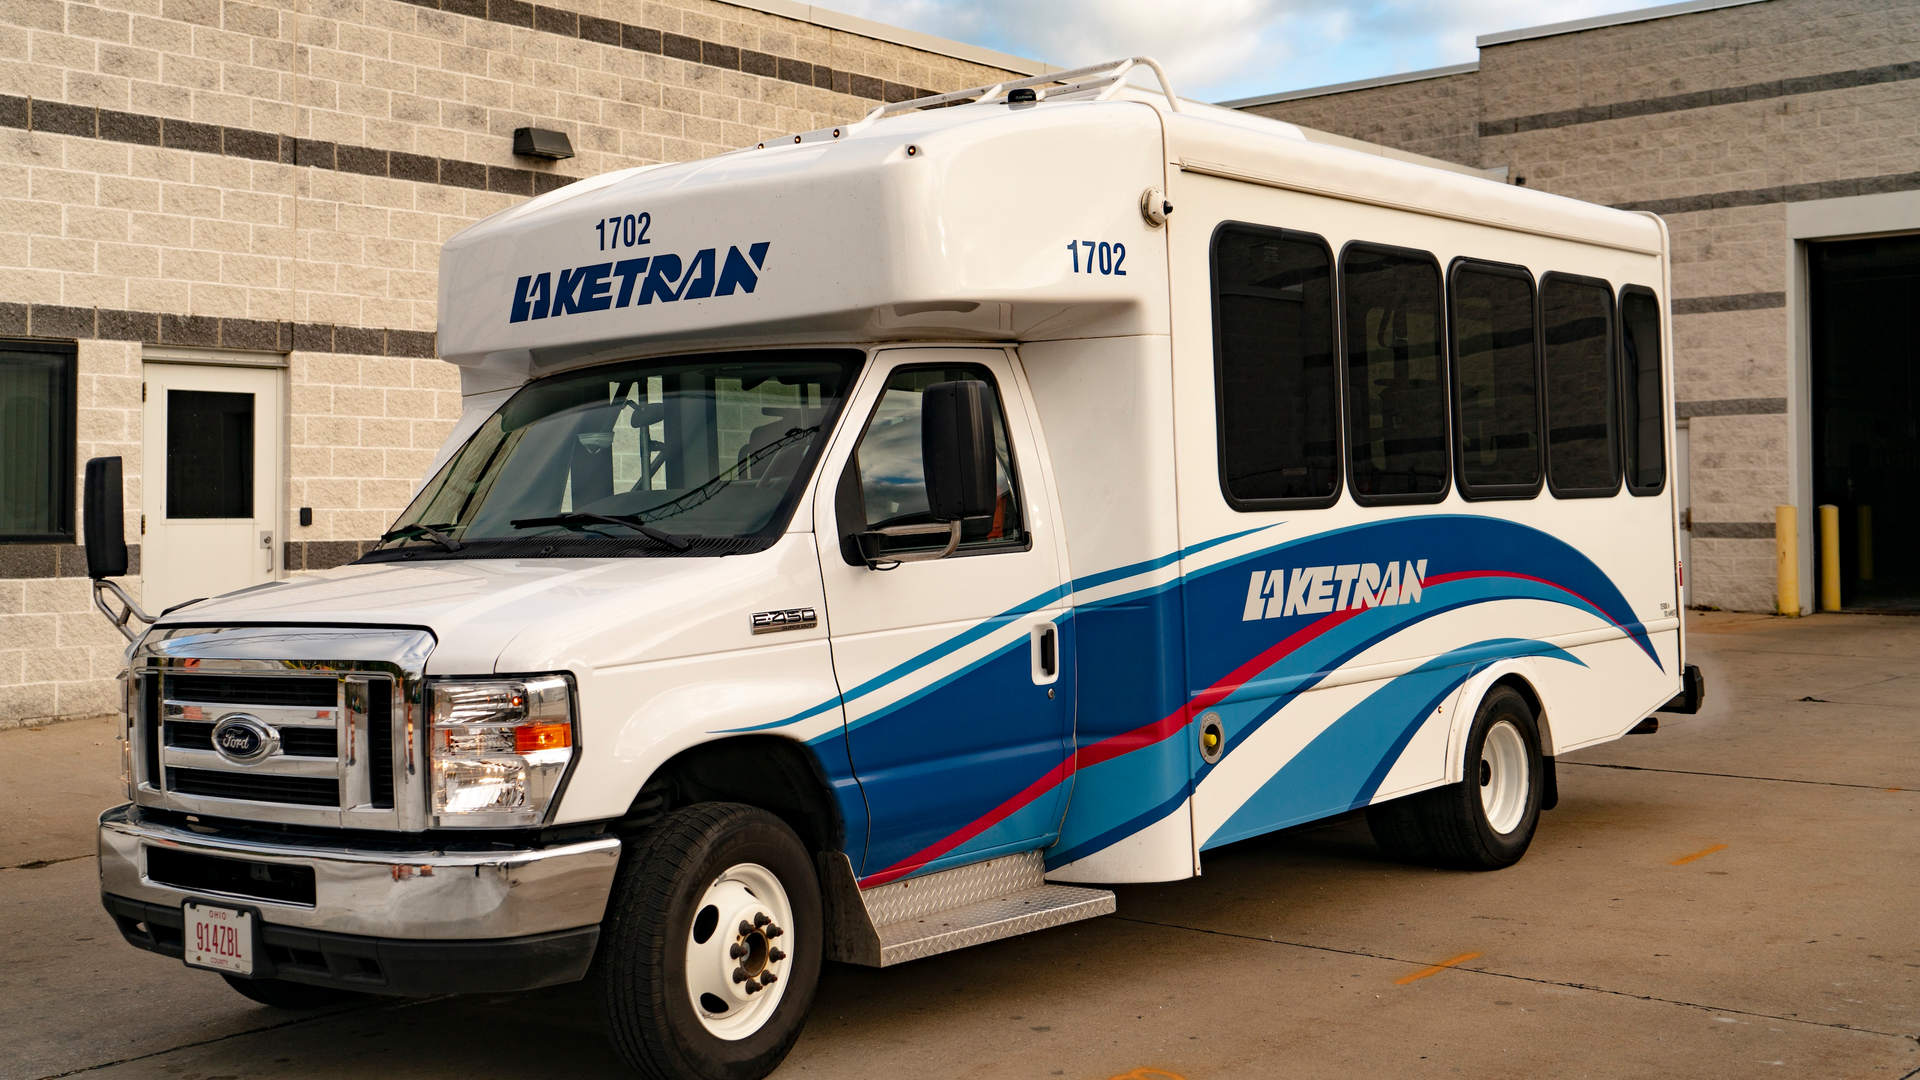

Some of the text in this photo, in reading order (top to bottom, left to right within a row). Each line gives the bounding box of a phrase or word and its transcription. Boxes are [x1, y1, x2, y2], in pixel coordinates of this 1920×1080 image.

[595, 211, 651, 251] 1702
[1066, 239, 1127, 276] 1702
[509, 241, 771, 324] LAKETRAN
[1242, 559, 1428, 622] LAKETRAN
[222, 728, 250, 749] Ford
[209, 910, 227, 921] OHIO
[196, 922, 242, 959] 914ZBL
[210, 957, 228, 967] COUNTY
